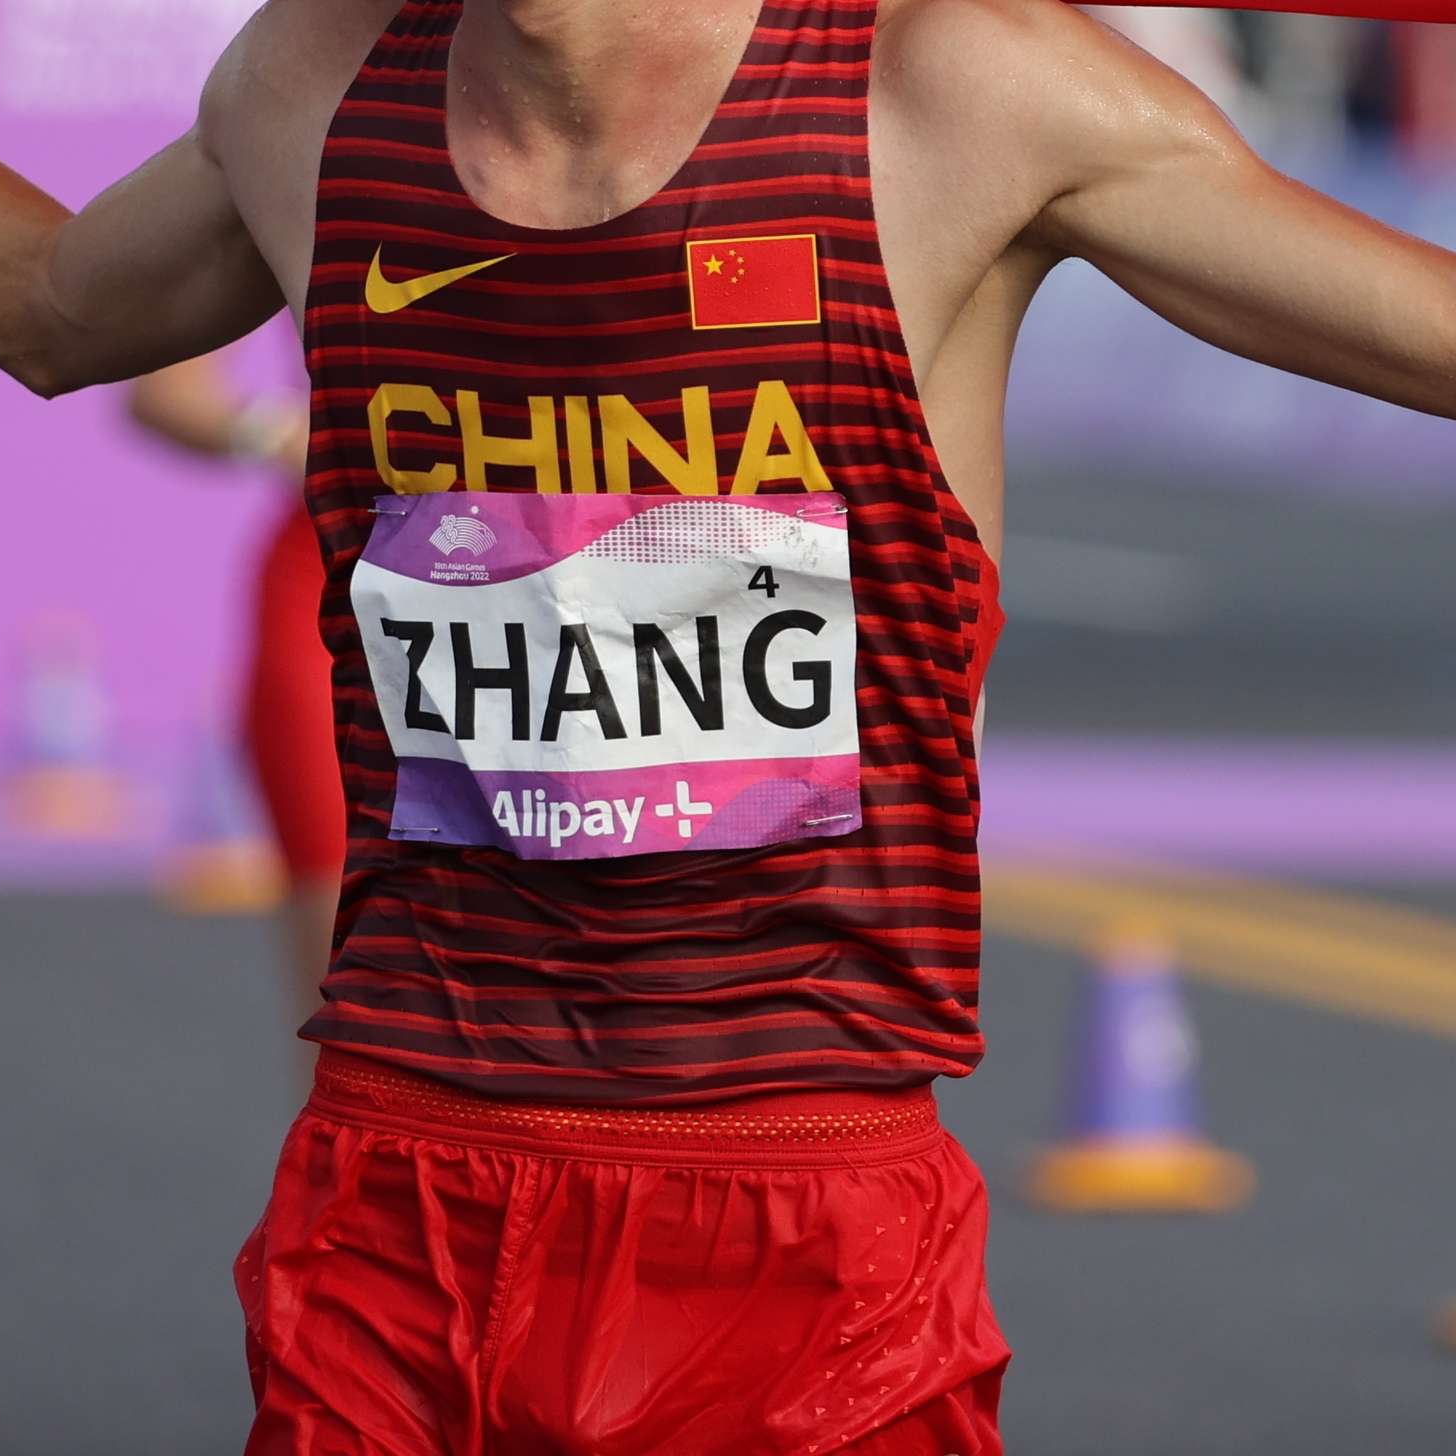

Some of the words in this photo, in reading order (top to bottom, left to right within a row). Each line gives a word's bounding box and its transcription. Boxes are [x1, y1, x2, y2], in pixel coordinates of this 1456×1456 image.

[367, 380, 835, 495] CHINA
[430, 570, 469, 581] Hangzhou
[470, 571, 490, 581] 2022
[465, 563, 486, 572] Games
[747, 565, 780, 599] 4
[380, 609, 832, 742] ZHANG
